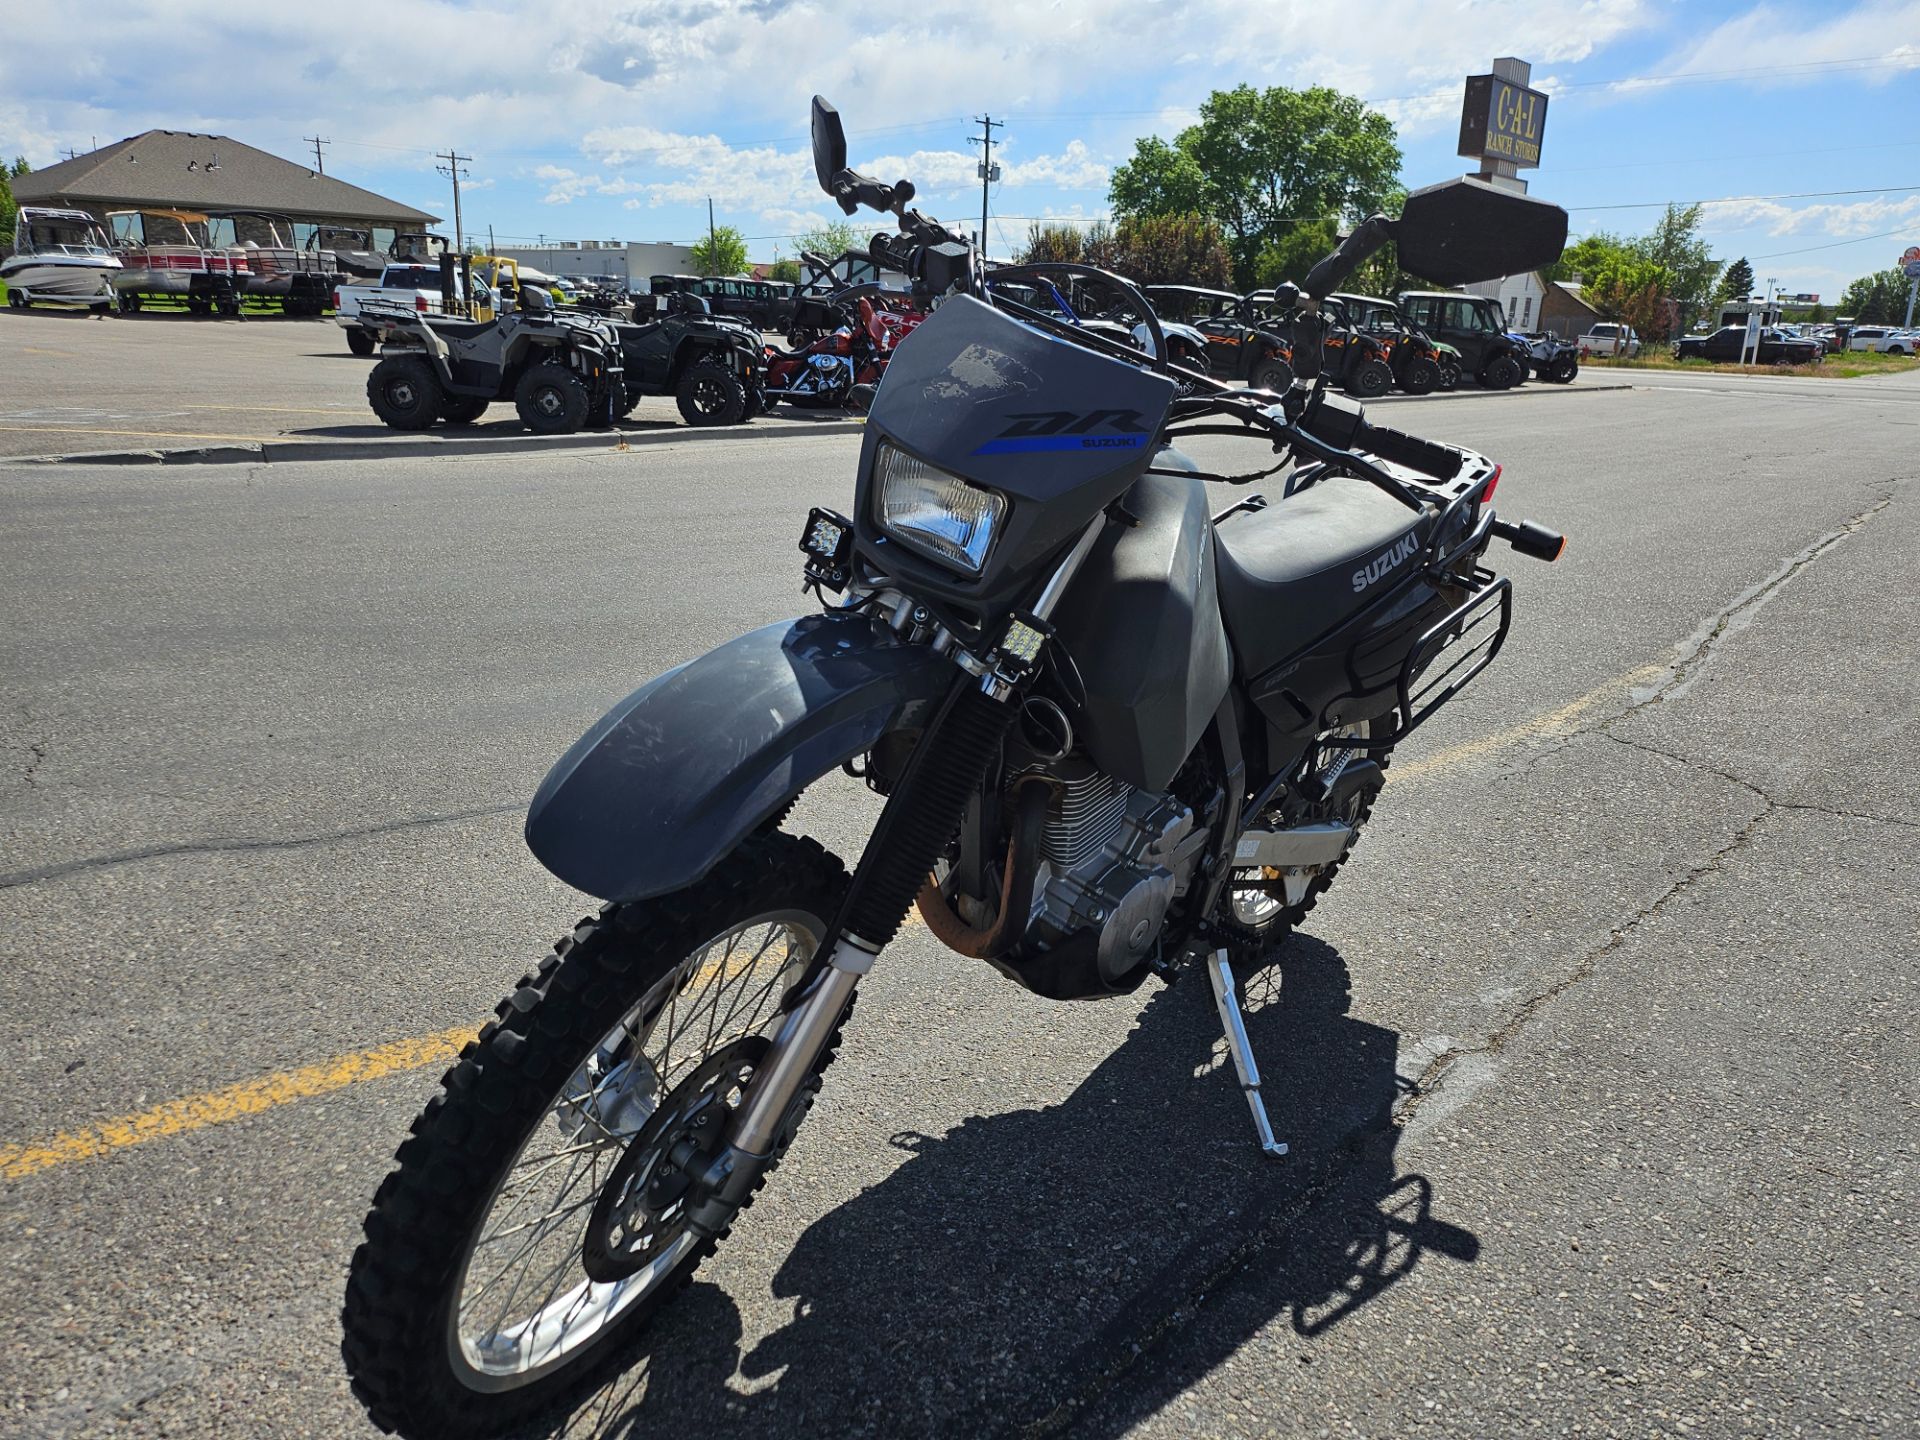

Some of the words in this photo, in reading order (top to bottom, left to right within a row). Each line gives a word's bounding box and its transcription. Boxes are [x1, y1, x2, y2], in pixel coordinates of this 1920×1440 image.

[1498, 86, 1536, 139] C-A-L
[1487, 131, 1512, 155] RANCH
[1515, 139, 1539, 162] STORES
[996, 409, 1149, 437] DR
[1082, 438, 1136, 448] SUZUKI
[1352, 531, 1419, 593] SUZUKI
